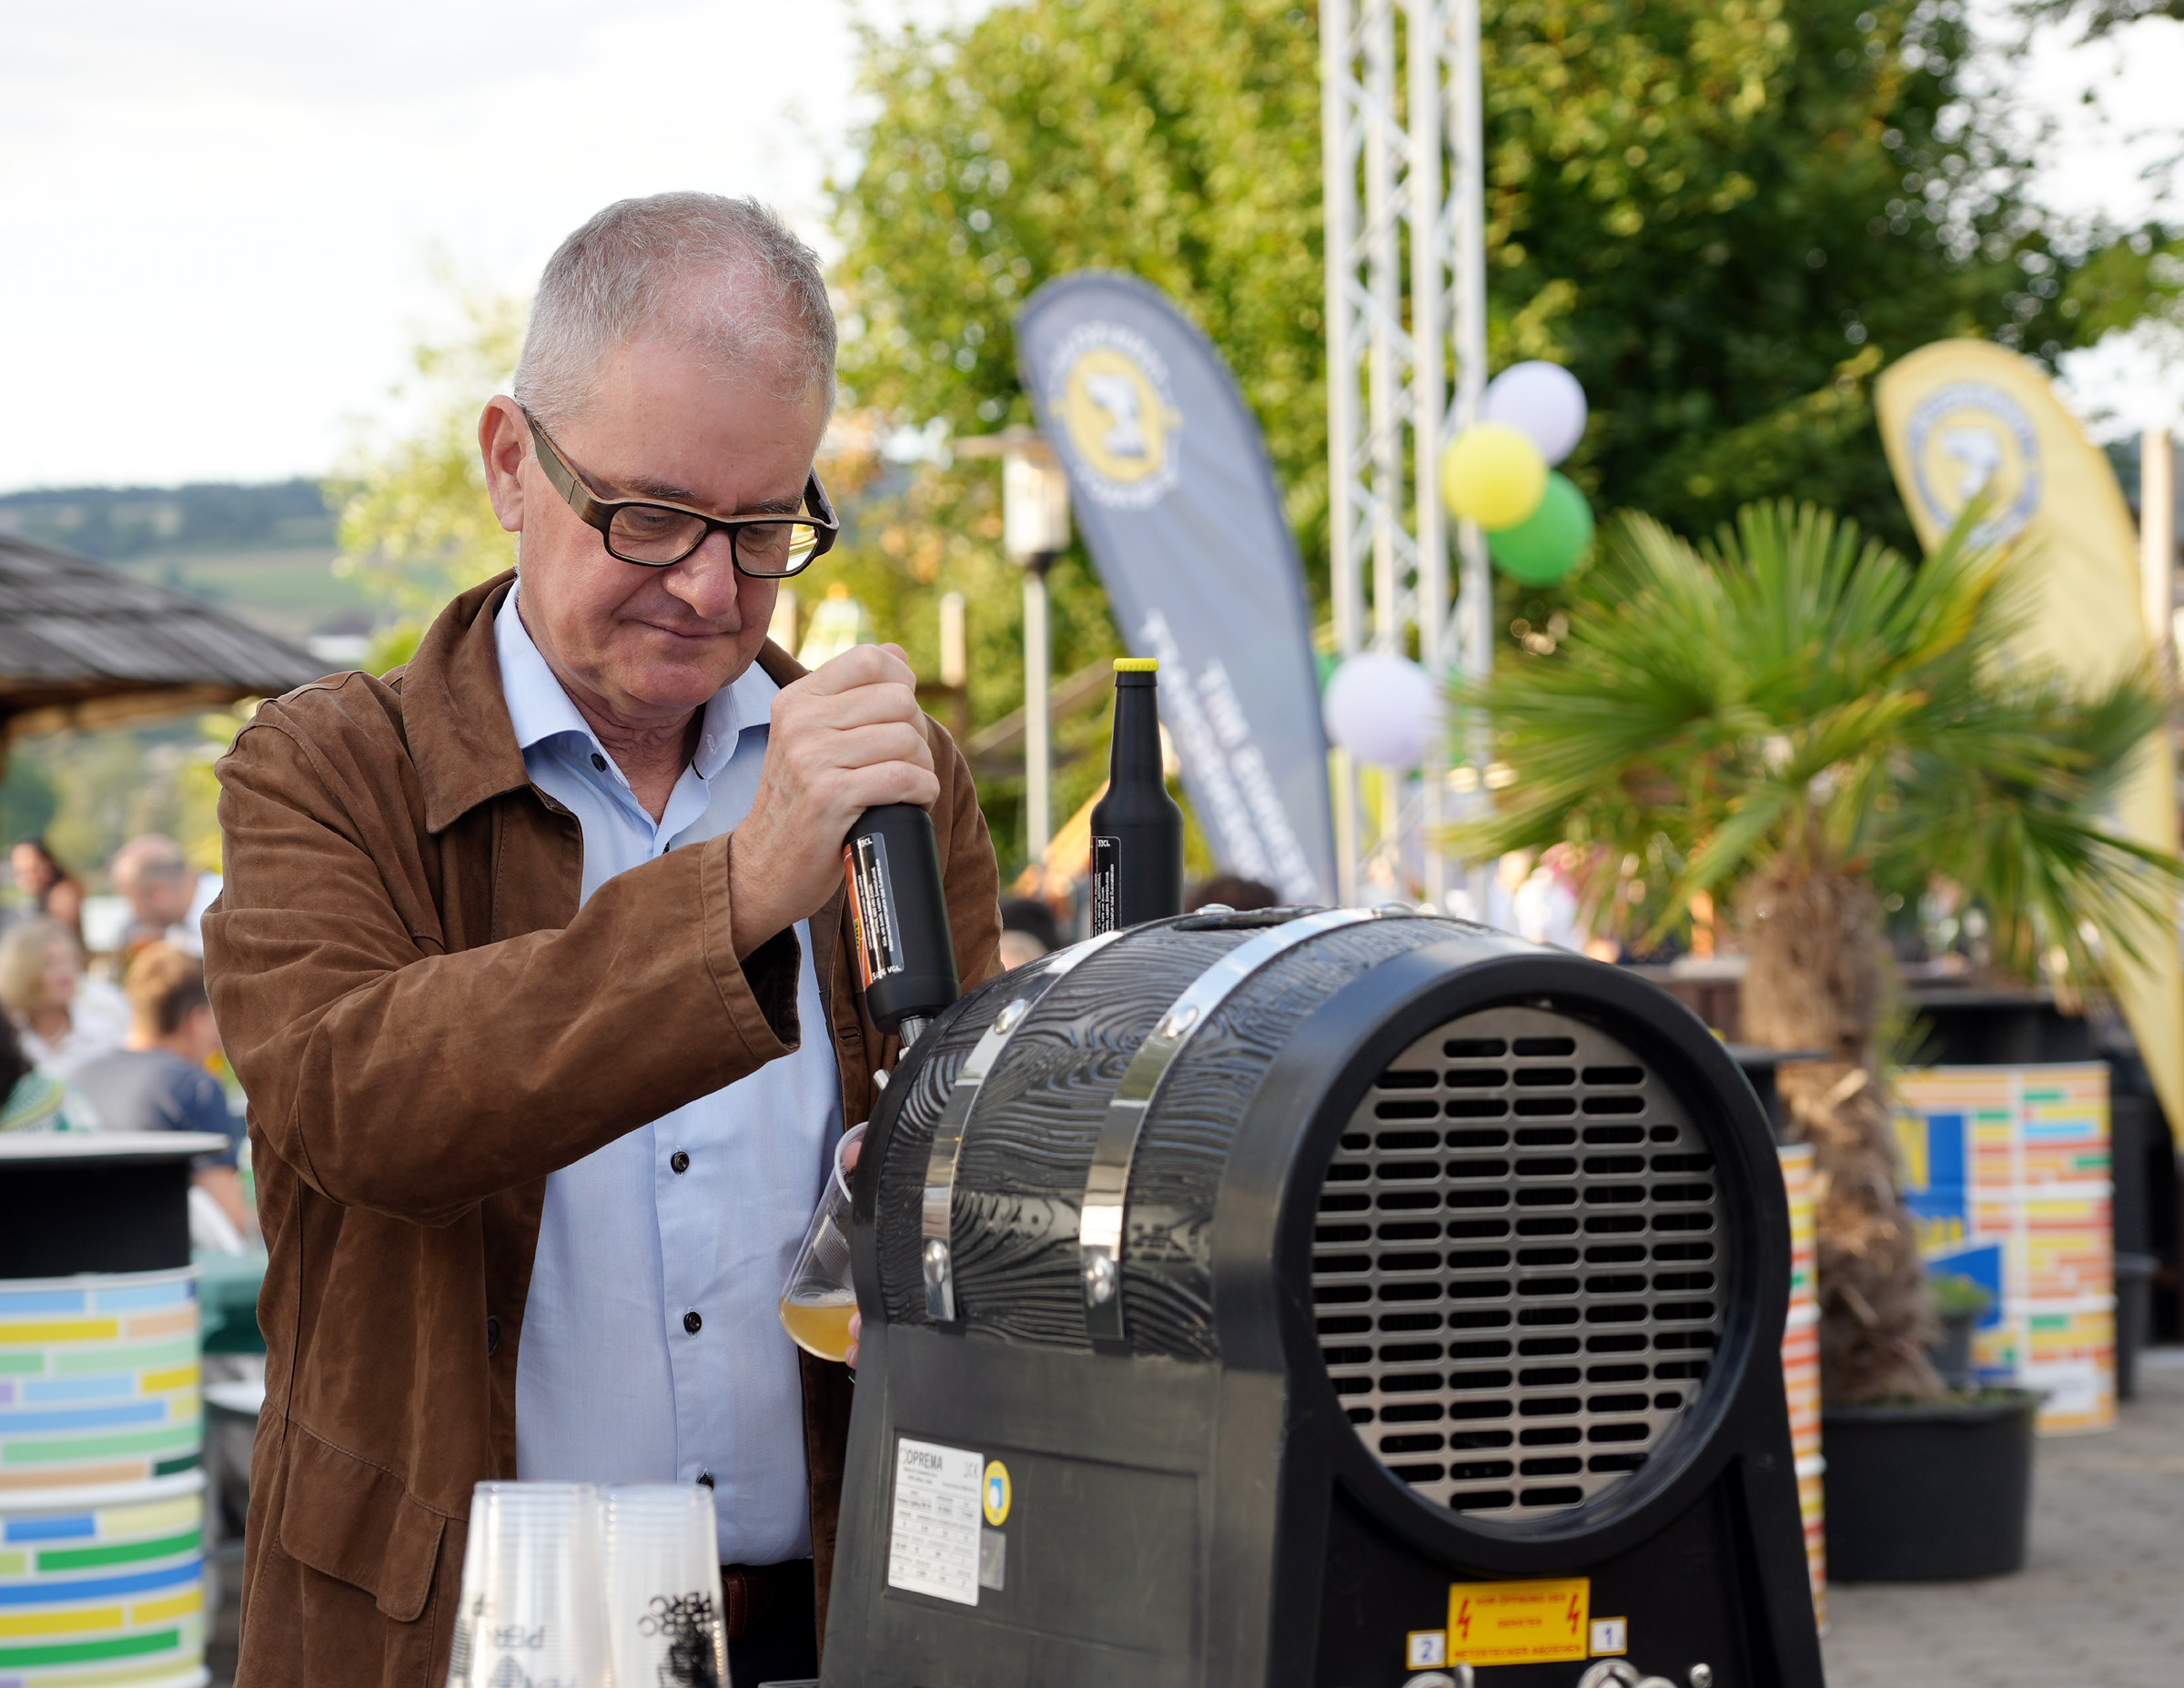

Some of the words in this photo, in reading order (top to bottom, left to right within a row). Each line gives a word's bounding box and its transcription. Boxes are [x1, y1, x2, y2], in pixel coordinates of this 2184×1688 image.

[1097, 839, 1110, 847] 33CL
[906, 1450, 943, 1471] OPREMA
[1605, 1626, 1613, 1647] 1
[1421, 1640, 1433, 1661] 2
